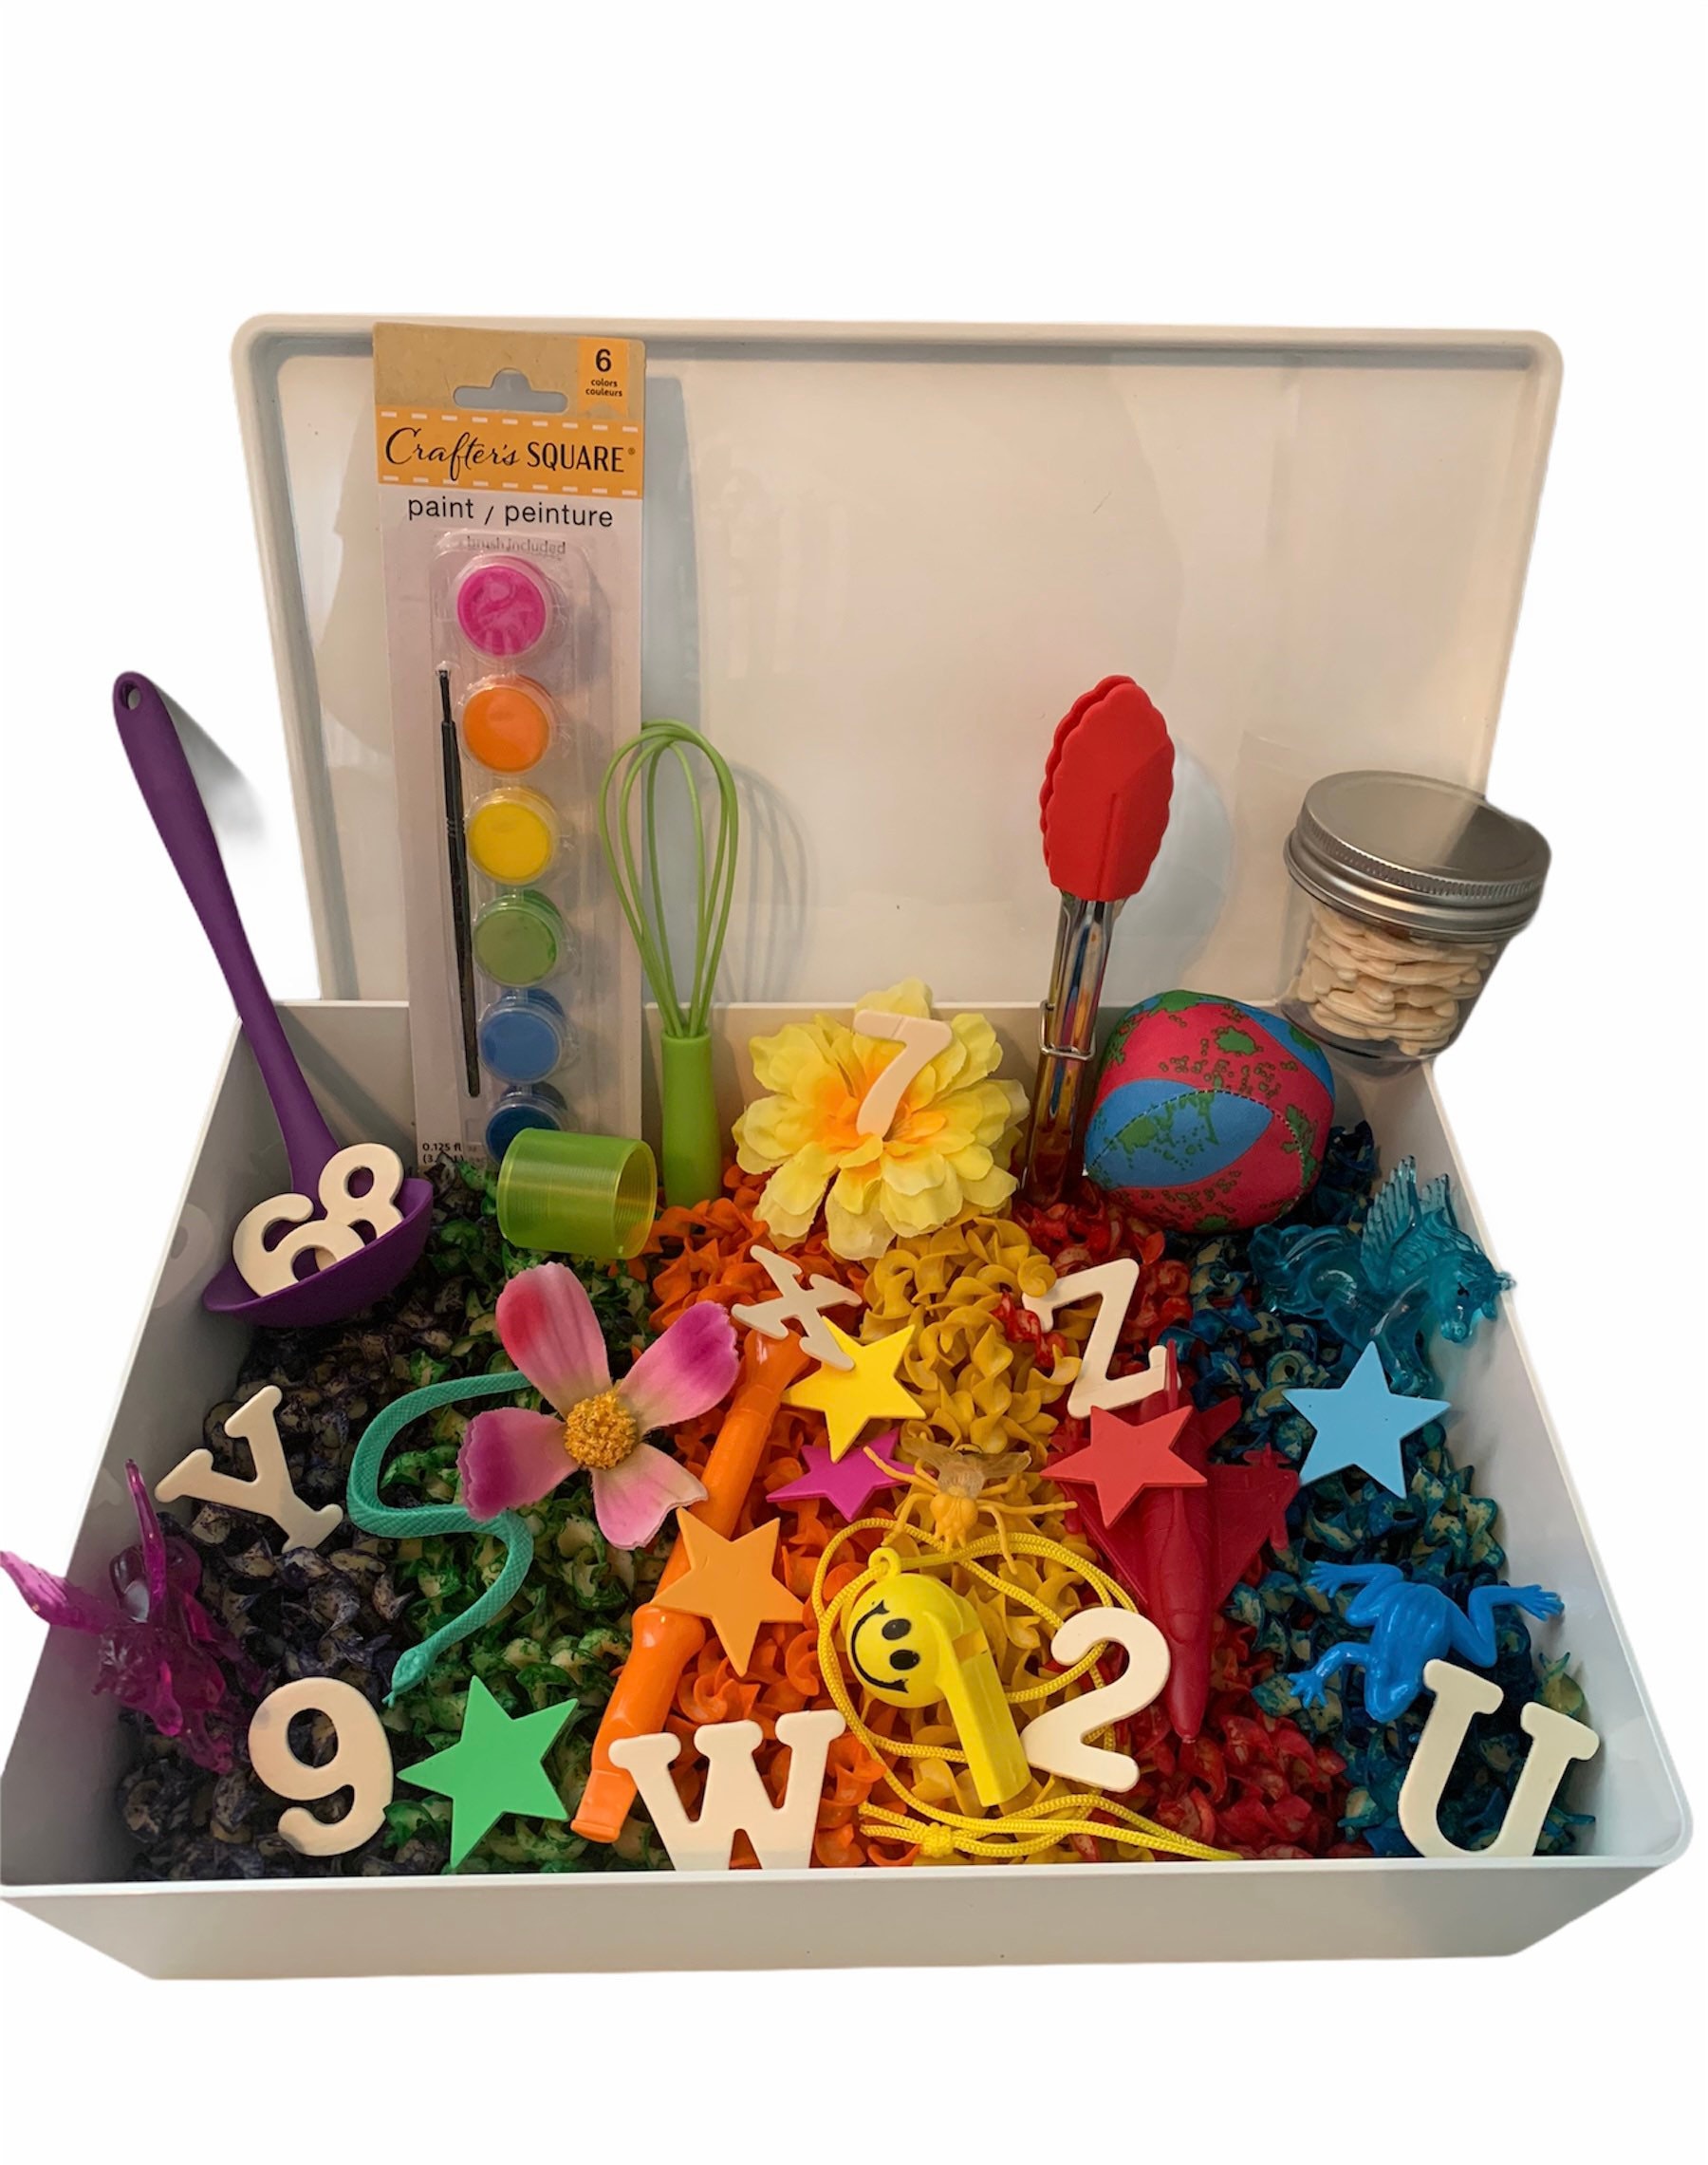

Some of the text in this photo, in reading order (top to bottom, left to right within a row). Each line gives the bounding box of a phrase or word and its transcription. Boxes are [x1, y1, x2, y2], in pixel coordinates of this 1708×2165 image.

[585, 387, 622, 397] couleurs
[590, 378, 618, 387] colors
[595, 348, 612, 372] 6
[385, 427, 520, 481] Crafter's
[408, 495, 473, 520] paint
[505, 502, 613, 528] peinture
[854, 1009, 952, 1139] 7
[422, 1142, 451, 1151] 0.125
[731, 1244, 862, 1371] X
[1022, 1258, 1181, 1419] Z
[155, 1385, 343, 1553] Y
[1021, 1606, 1170, 1792] 2
[1398, 1658, 1600, 1857] U
[249, 1676, 394, 1857] 9
[609, 1708, 846, 1871] W
